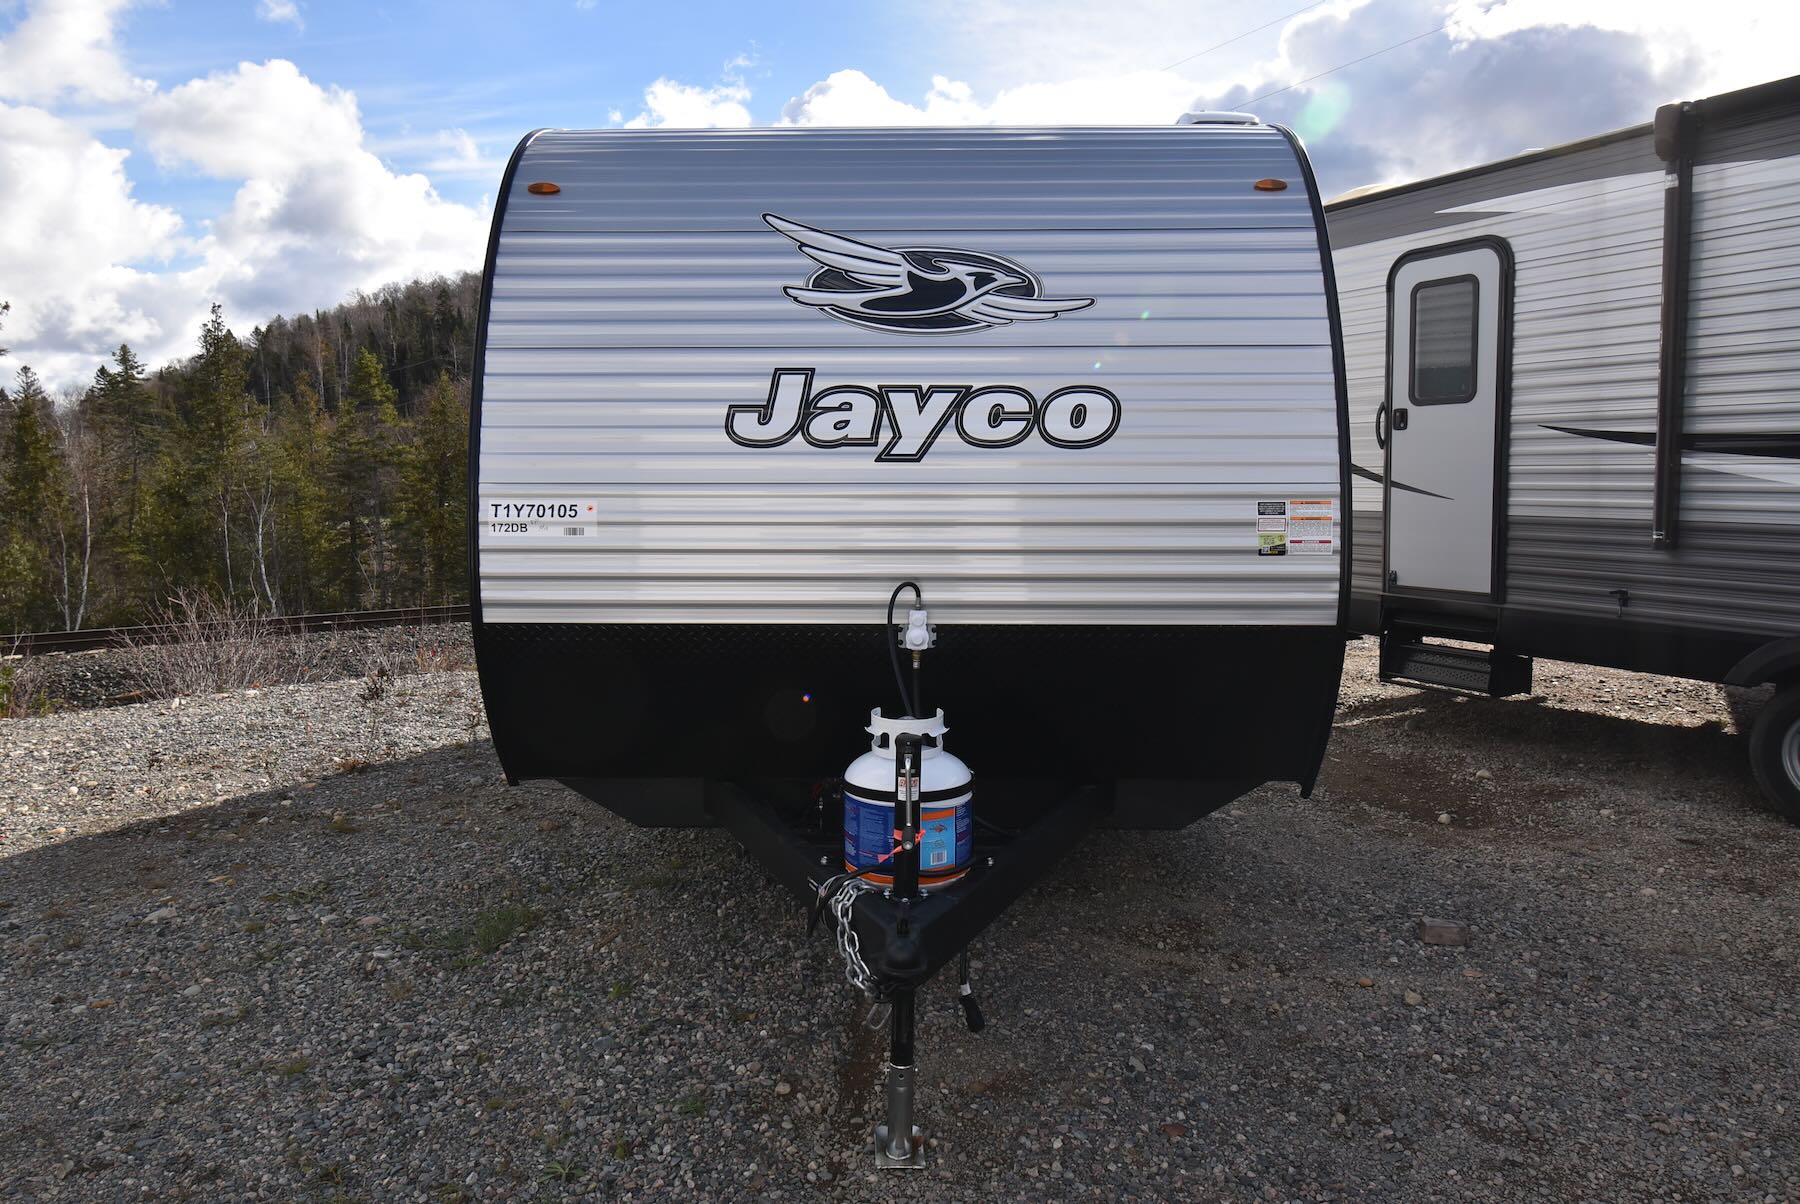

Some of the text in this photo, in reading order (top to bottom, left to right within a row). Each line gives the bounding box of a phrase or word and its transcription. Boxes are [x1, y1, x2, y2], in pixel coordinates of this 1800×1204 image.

[725, 367, 1122, 462] Jayco
[490, 503, 578, 518] T1Y70105
[490, 523, 528, 533] 172DB
